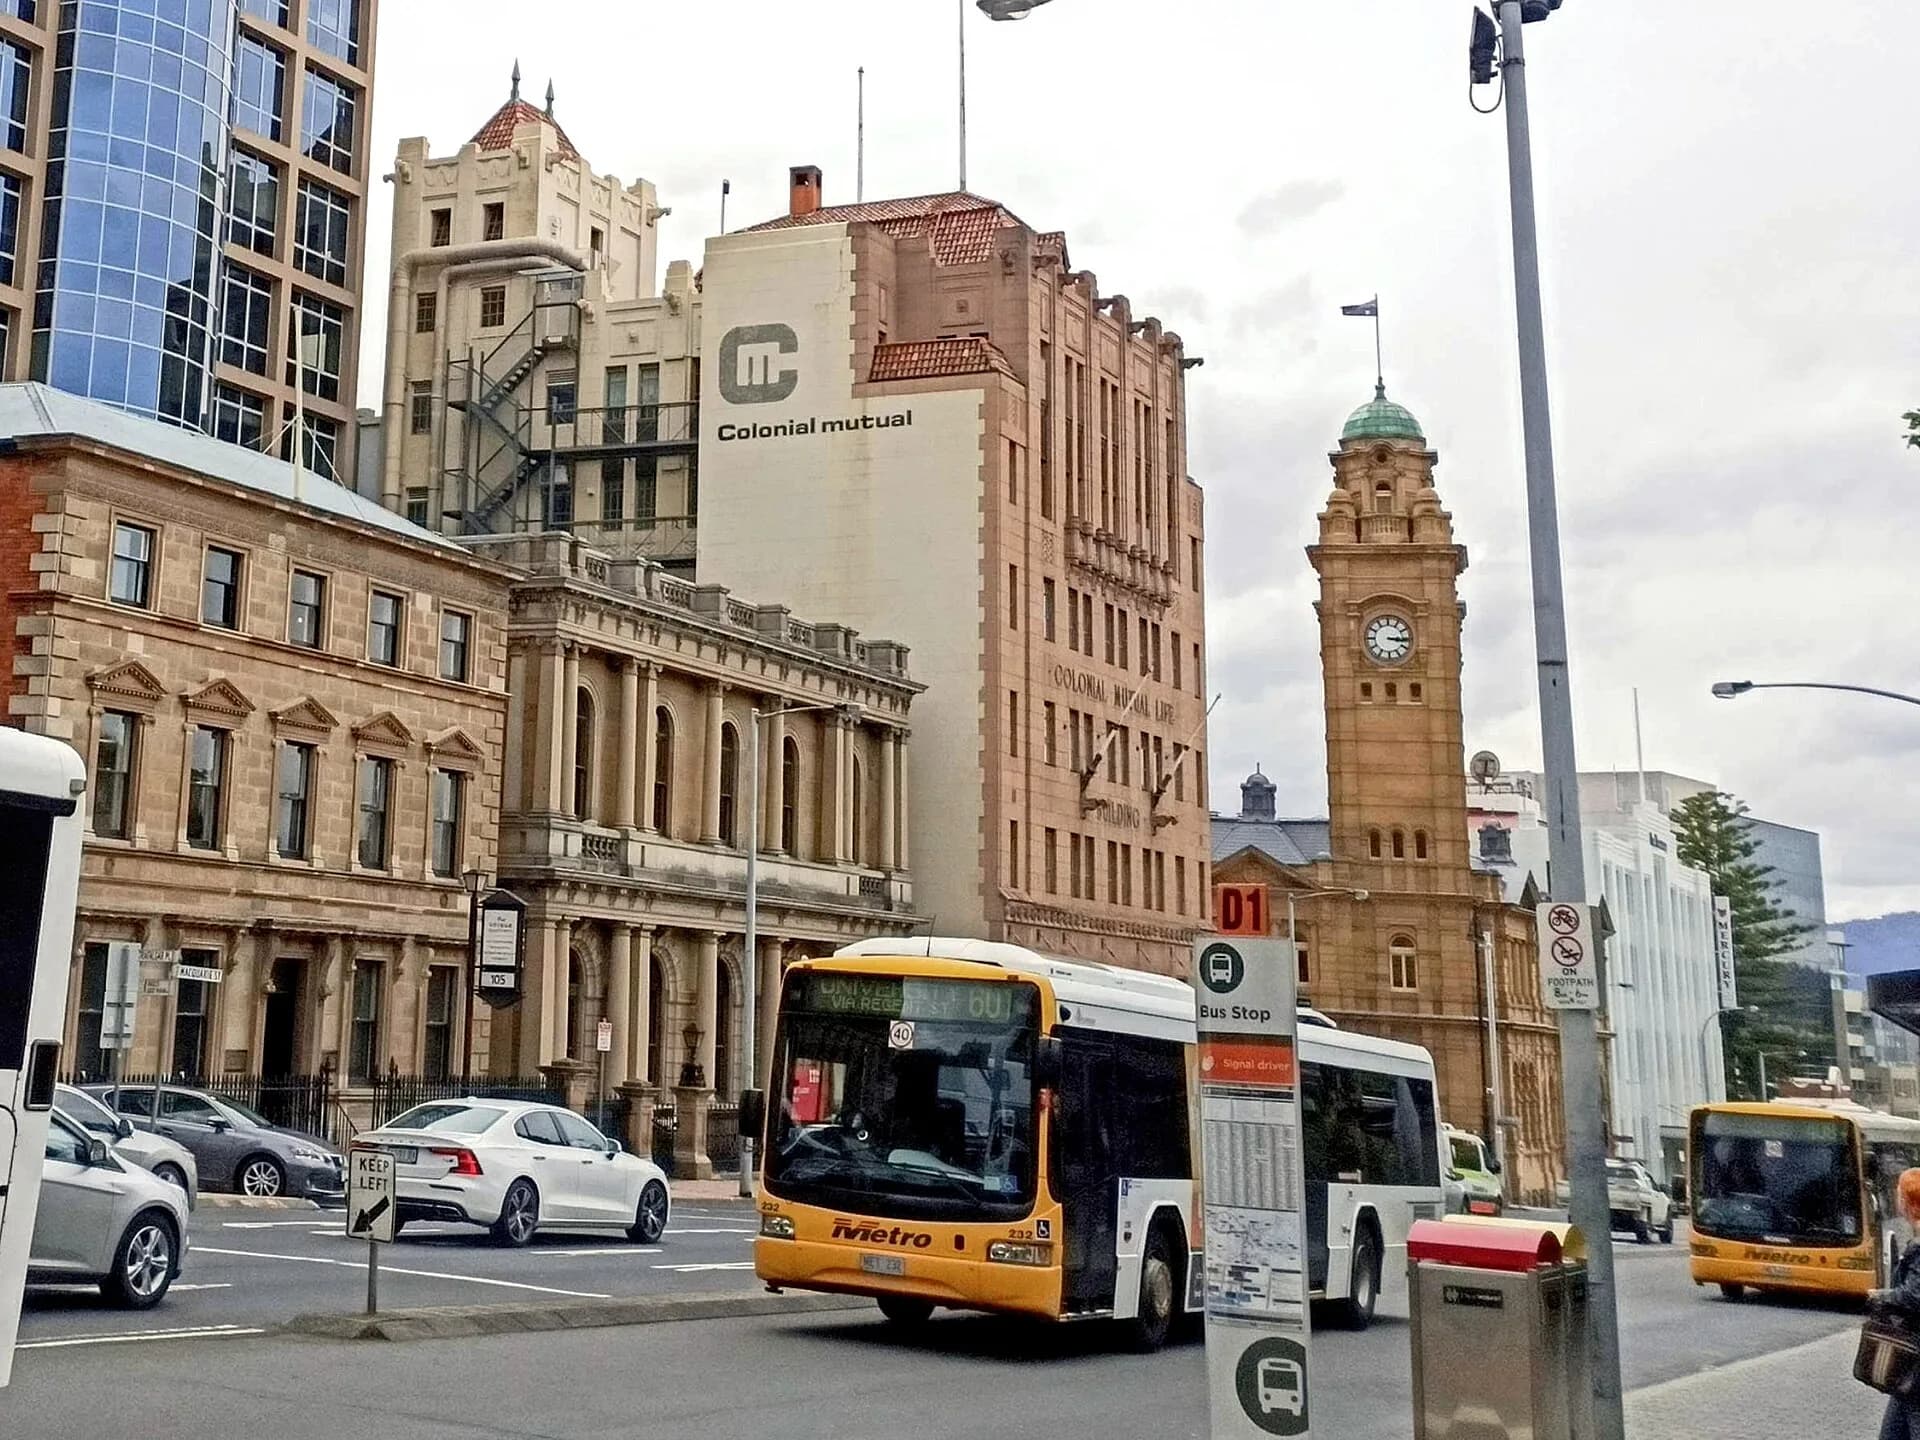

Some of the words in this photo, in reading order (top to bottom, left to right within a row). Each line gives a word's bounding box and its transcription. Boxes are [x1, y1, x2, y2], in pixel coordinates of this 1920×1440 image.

[718, 418, 815, 441] Colonial
[822, 410, 913, 433] mutual
[1054, 664, 1107, 702] COLONIAL
[1155, 699, 1176, 726] LIFE
[1222, 887, 1260, 931] D1
[491, 974, 506, 985] 105
[1562, 967, 1577, 976] ON
[1548, 977, 1594, 988] FOOTPATH
[831, 994, 856, 1010] VIA
[1200, 1005, 1226, 1018] Bus
[1232, 1006, 1271, 1023] Stop
[893, 1027, 910, 1041] 40
[1223, 1058, 1255, 1071] Signal
[1257, 1060, 1290, 1071] driver
[360, 1157, 389, 1173] KEEP
[360, 1175, 388, 1191] LEFT
[832, 1217, 932, 1249] Metro
[1008, 1228, 1033, 1240] 232
